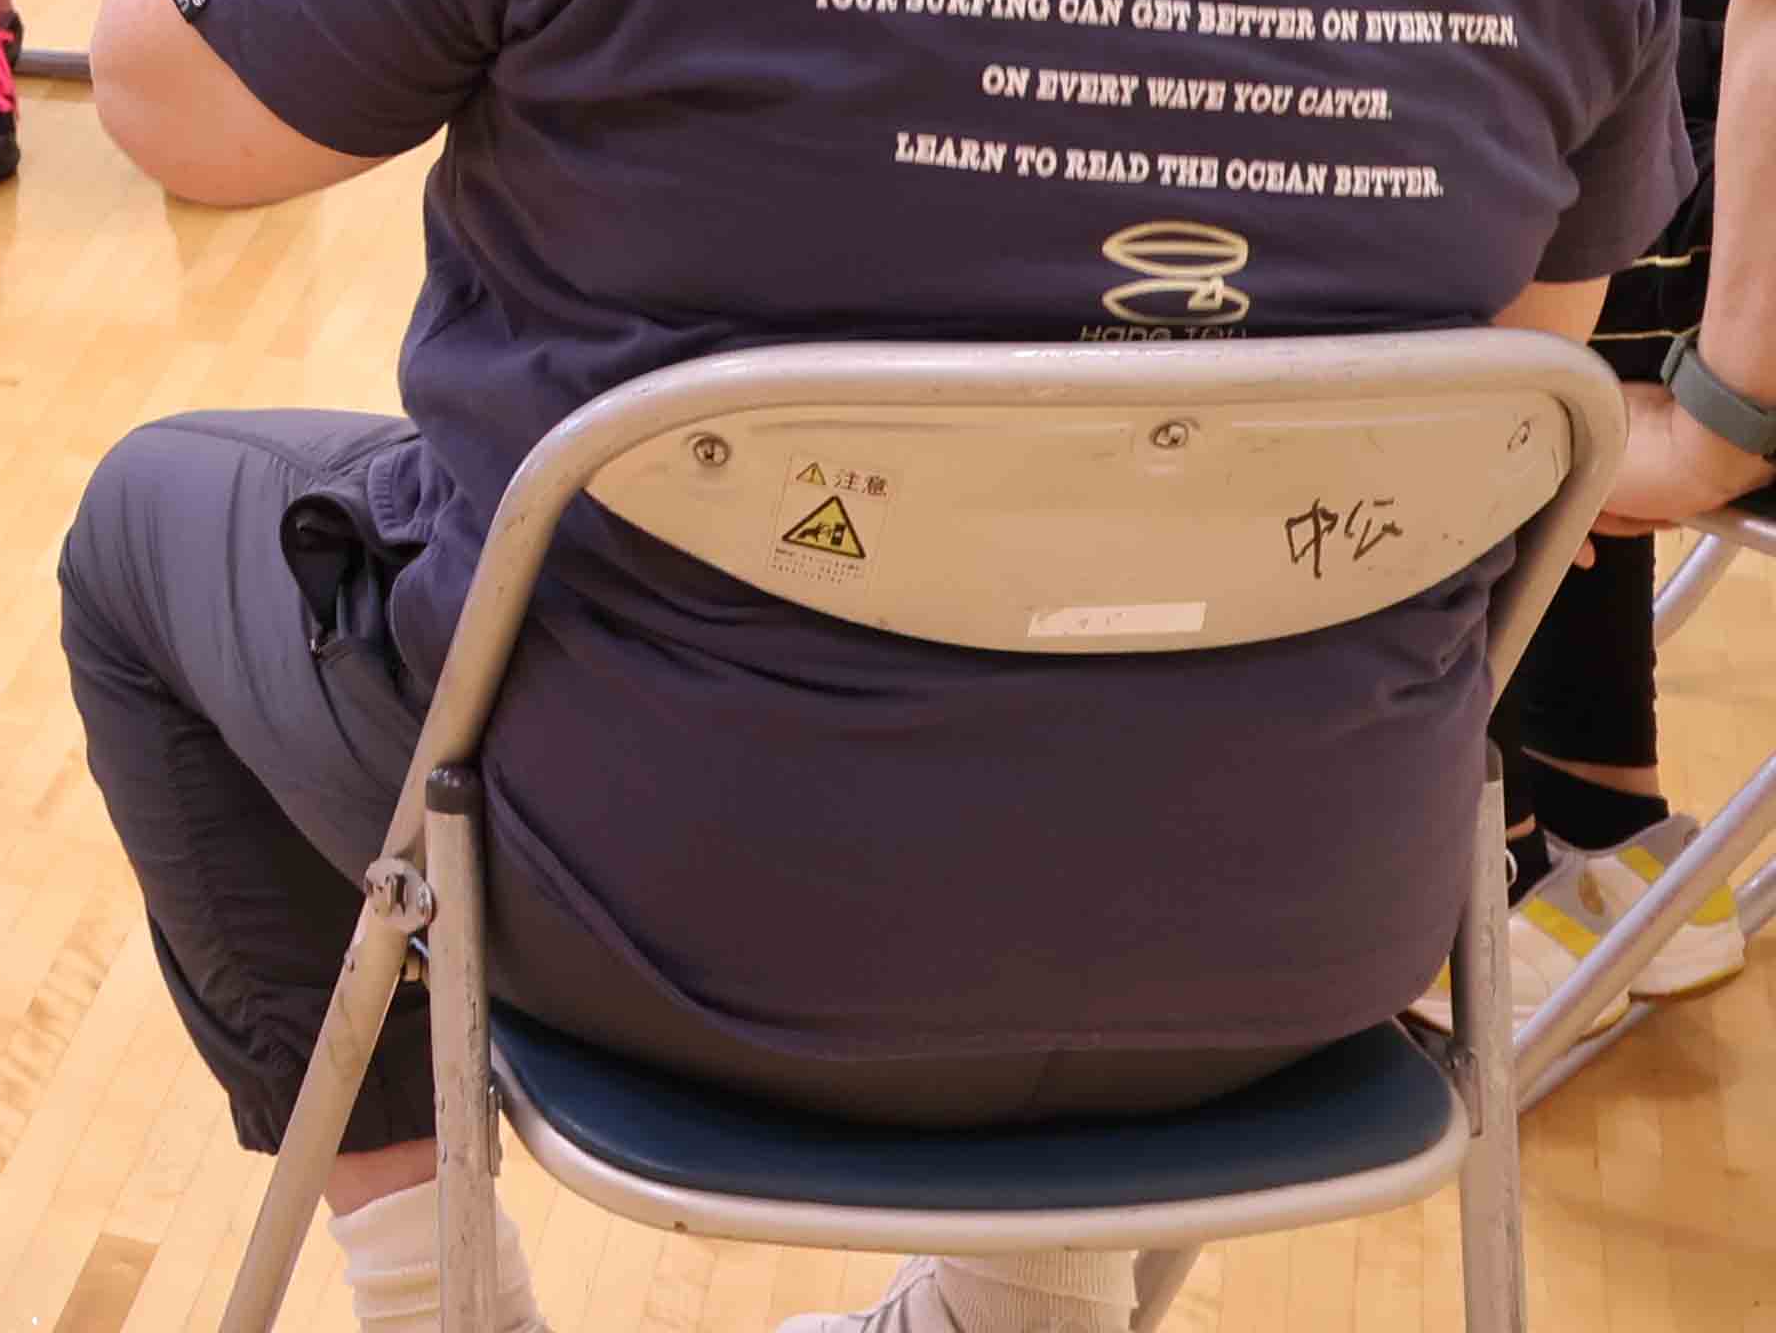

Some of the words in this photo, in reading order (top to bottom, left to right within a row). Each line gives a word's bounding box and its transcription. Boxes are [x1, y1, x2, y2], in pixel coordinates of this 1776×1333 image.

[1197, 1, 1315, 40] BETTER
[1322, 8, 1359, 42] ON
[1365, 10, 1443, 44] EVERY
[1447, 12, 1518, 48] TURN.
[981, 64, 1031, 98] ON
[1035, 69, 1140, 107] EVERY
[1147, 76, 1226, 111] WAVE
[1233, 83, 1293, 115] YOU
[1297, 86, 1393, 121] CATCH.
[894, 132, 1008, 174] LEARN
[1015, 145, 1057, 178] TO
[1064, 148, 1150, 183] READ
[1157, 154, 1218, 188] THE
[1225, 158, 1328, 195] OCEAN
[1334, 164, 1444, 198] BETTER.
[831, 470, 888, 498] 注意
